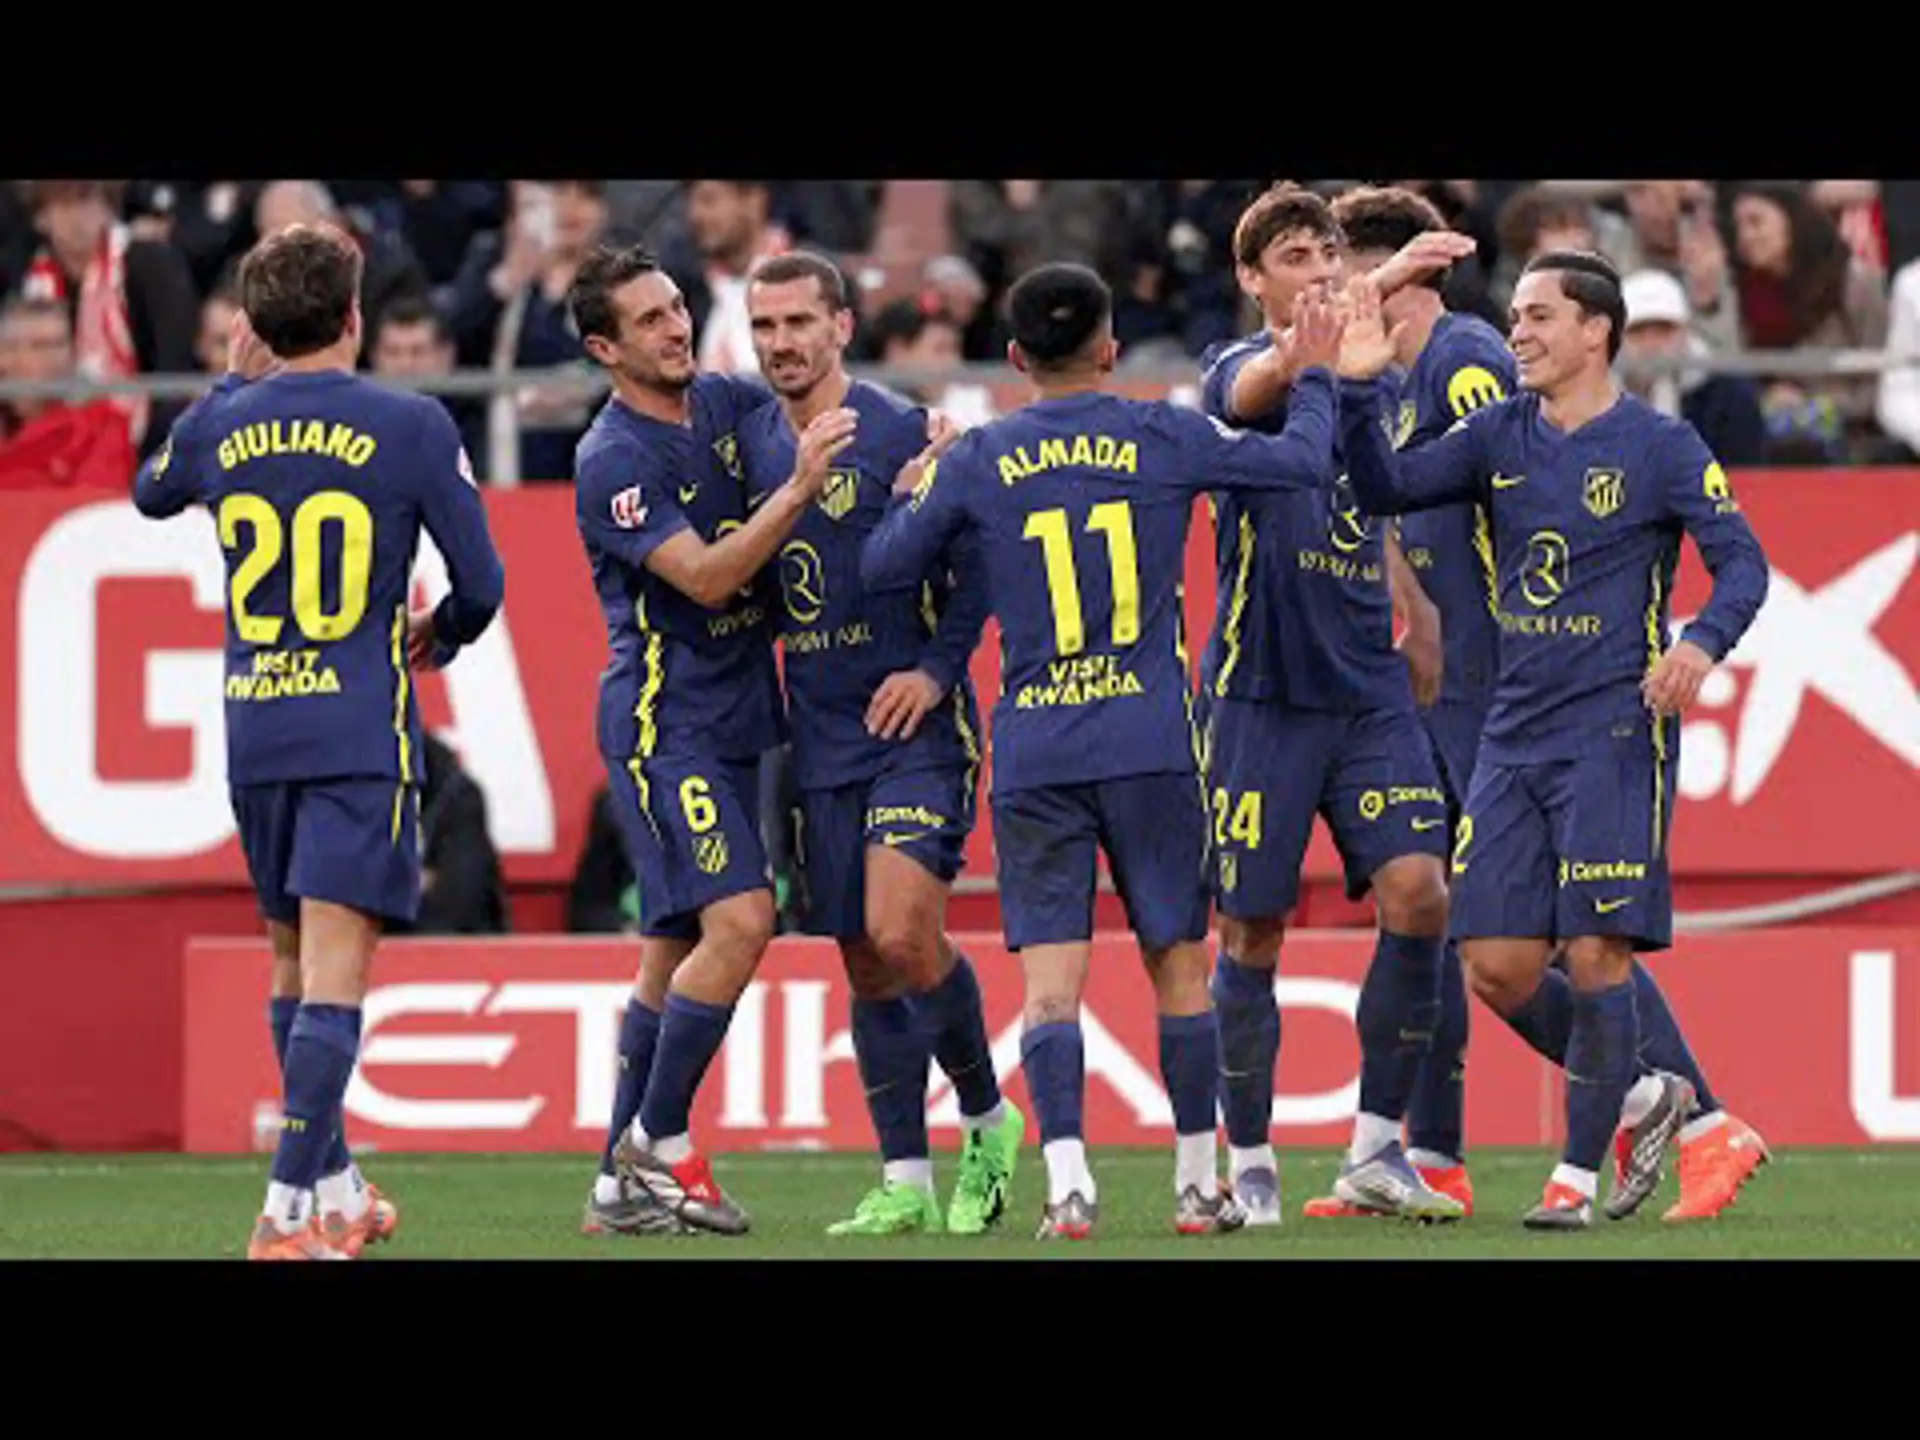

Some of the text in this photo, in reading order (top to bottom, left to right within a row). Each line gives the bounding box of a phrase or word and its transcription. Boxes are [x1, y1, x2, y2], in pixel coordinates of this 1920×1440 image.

[218, 420, 376, 468] GIULIANO
[997, 434, 1138, 486] ALMADA
[217, 490, 373, 643] 20
[1022, 499, 1141, 657] 11
[227, 666, 341, 700] RWANDA
[254, 650, 320, 675] VISIT
[1047, 655, 1120, 683] VISIT
[1016, 671, 1145, 708] RWANDA
[679, 776, 718, 833] 6
[1212, 787, 1262, 850] 24
